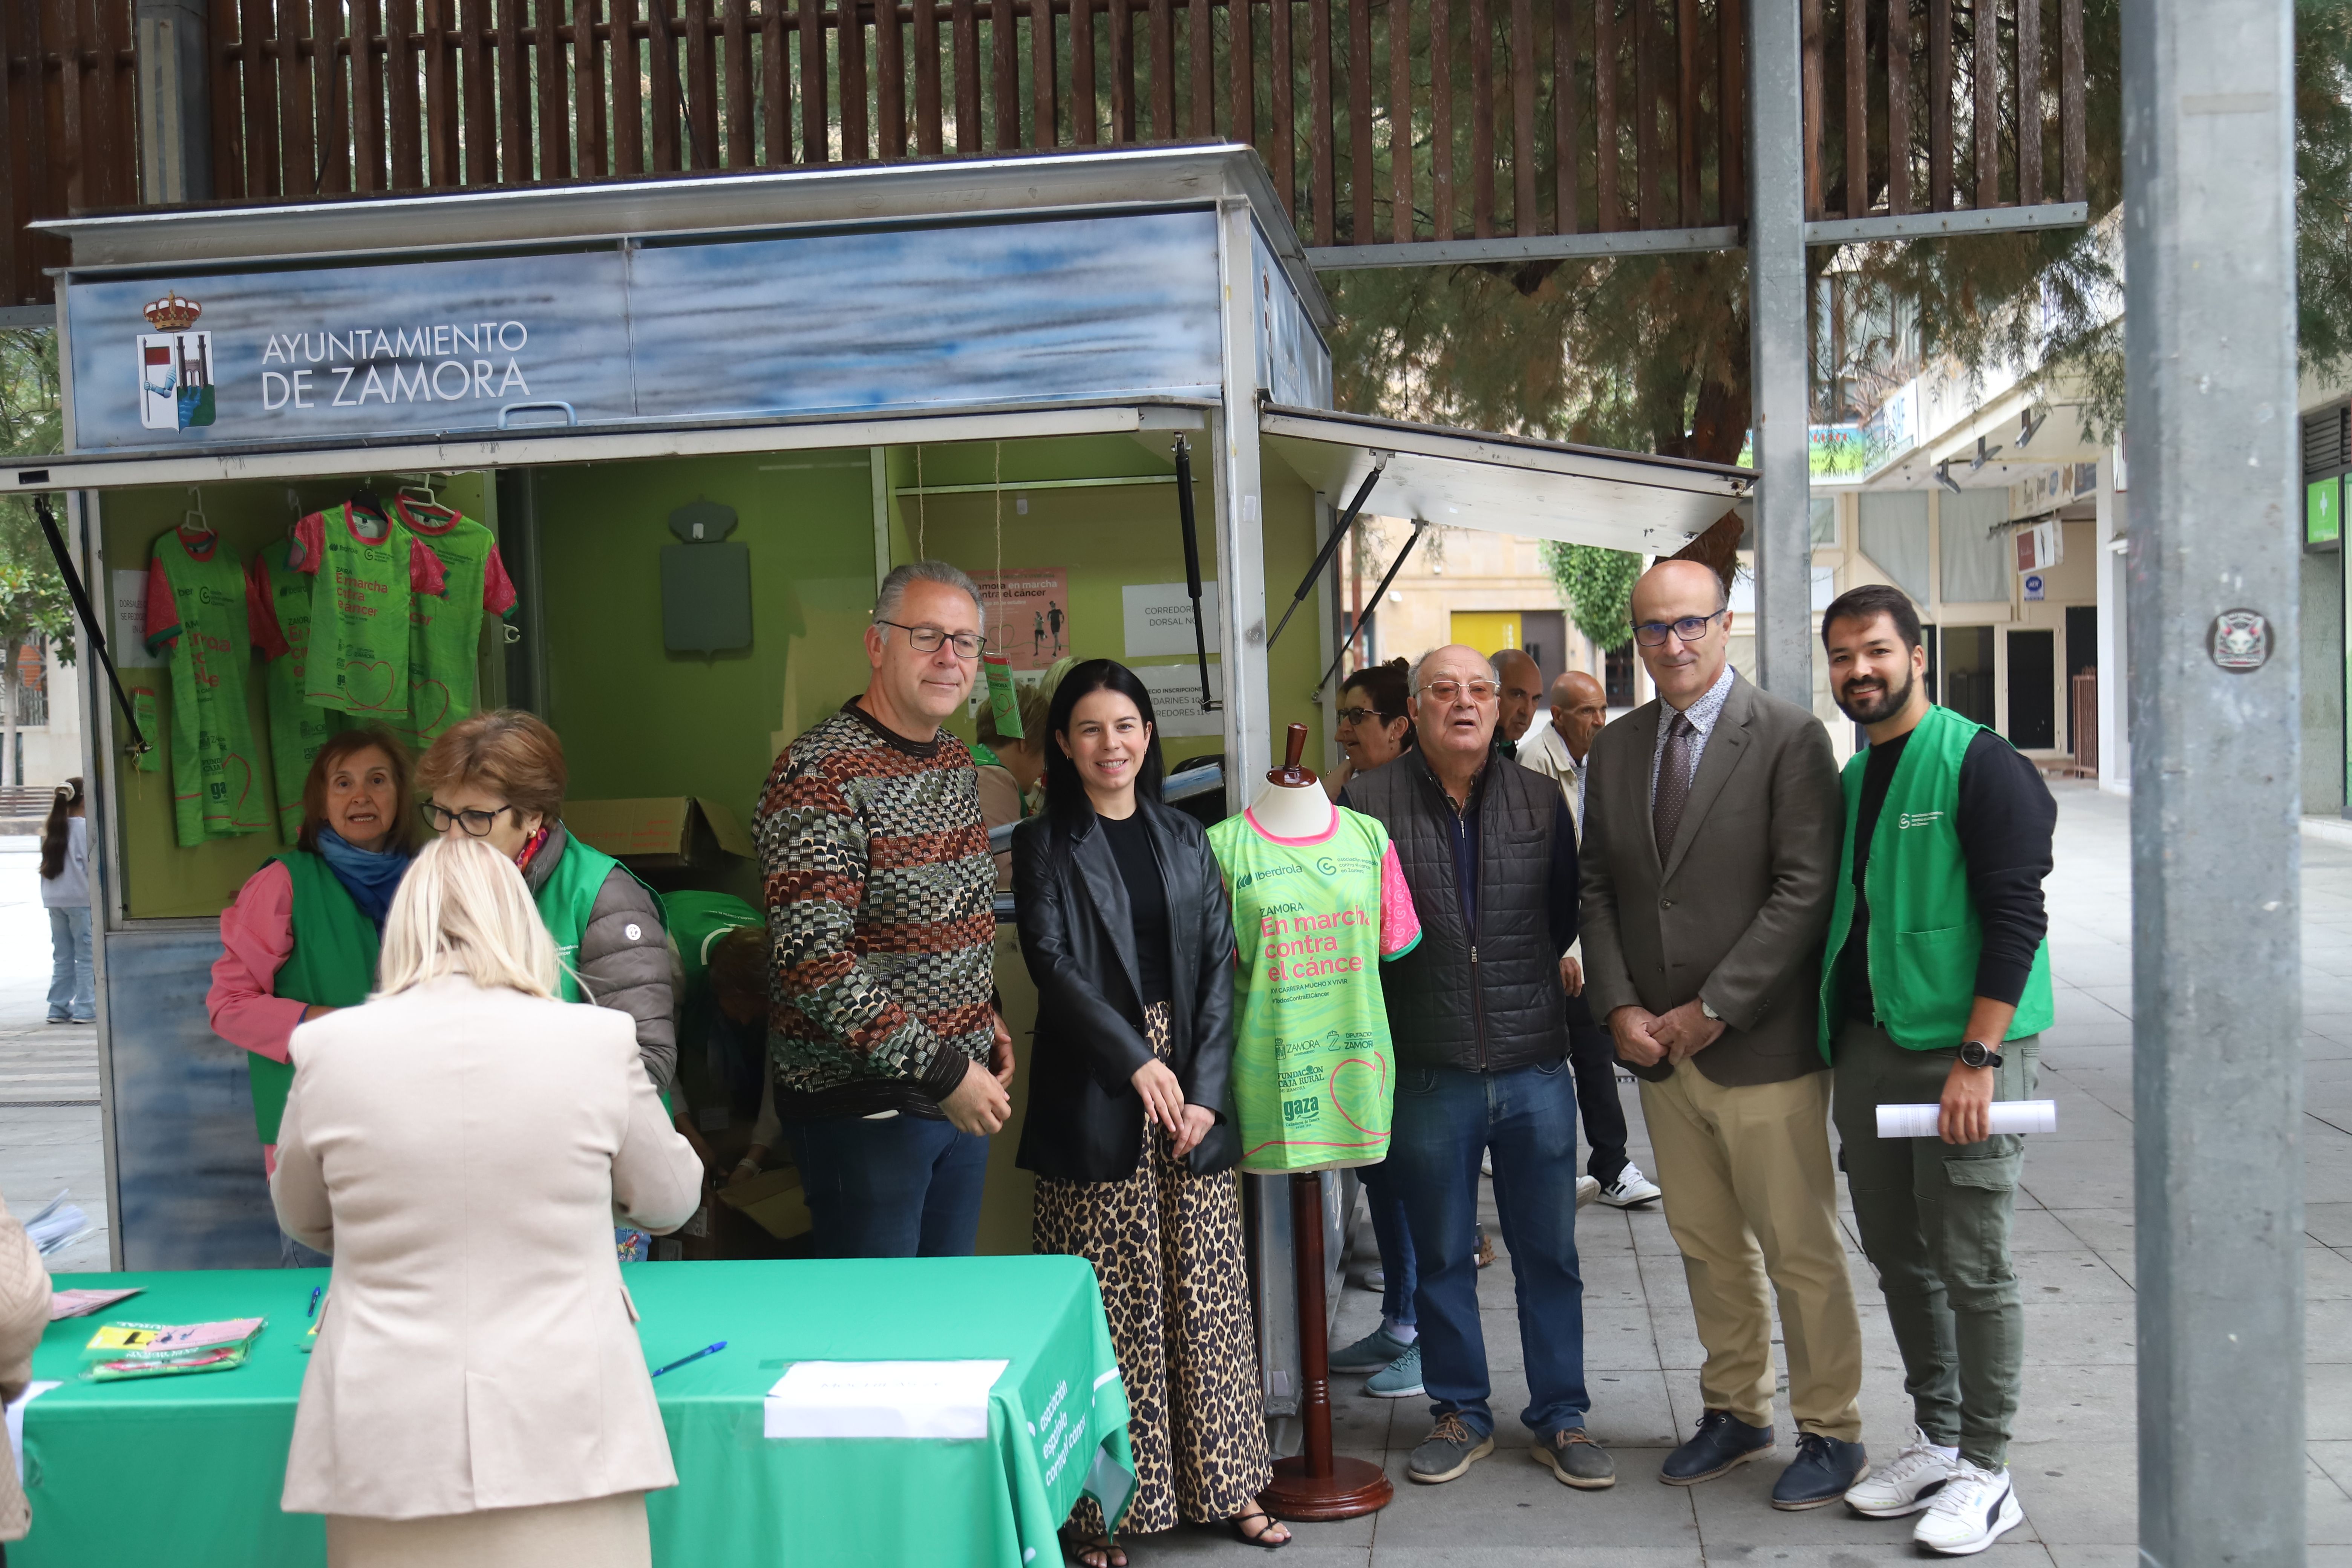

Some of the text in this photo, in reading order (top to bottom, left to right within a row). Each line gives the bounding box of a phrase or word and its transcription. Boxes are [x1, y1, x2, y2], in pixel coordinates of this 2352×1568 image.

[262, 321, 527, 364] AYUNTAMIENTO
[262, 357, 531, 411] DE ZAMORA
[345, 577, 388, 593] marcha
[1022, 580, 1058, 589] marcha
[1014, 589, 1046, 597] cáncer
[345, 601, 378, 617] áncer
[1149, 617, 1184, 627] DORSAL
[1255, 864, 1303, 882] Iberdrola
[1260, 902, 1305, 917] ZAMORA
[1260, 916, 1289, 938] En
[1265, 934, 1338, 959] contra
[1268, 956, 1364, 982] el cánce
[1278, 985, 1304, 994] CARRERA
[1272, 991, 1330, 1004] #TodosContraElCáncer
[1286, 1039, 1321, 1054] ZAMORA
[1344, 1040, 1374, 1050] ZAMOR
[1278, 1074, 1325, 1088] CAJA RURAL
[1283, 1096, 1319, 1121] gaza
